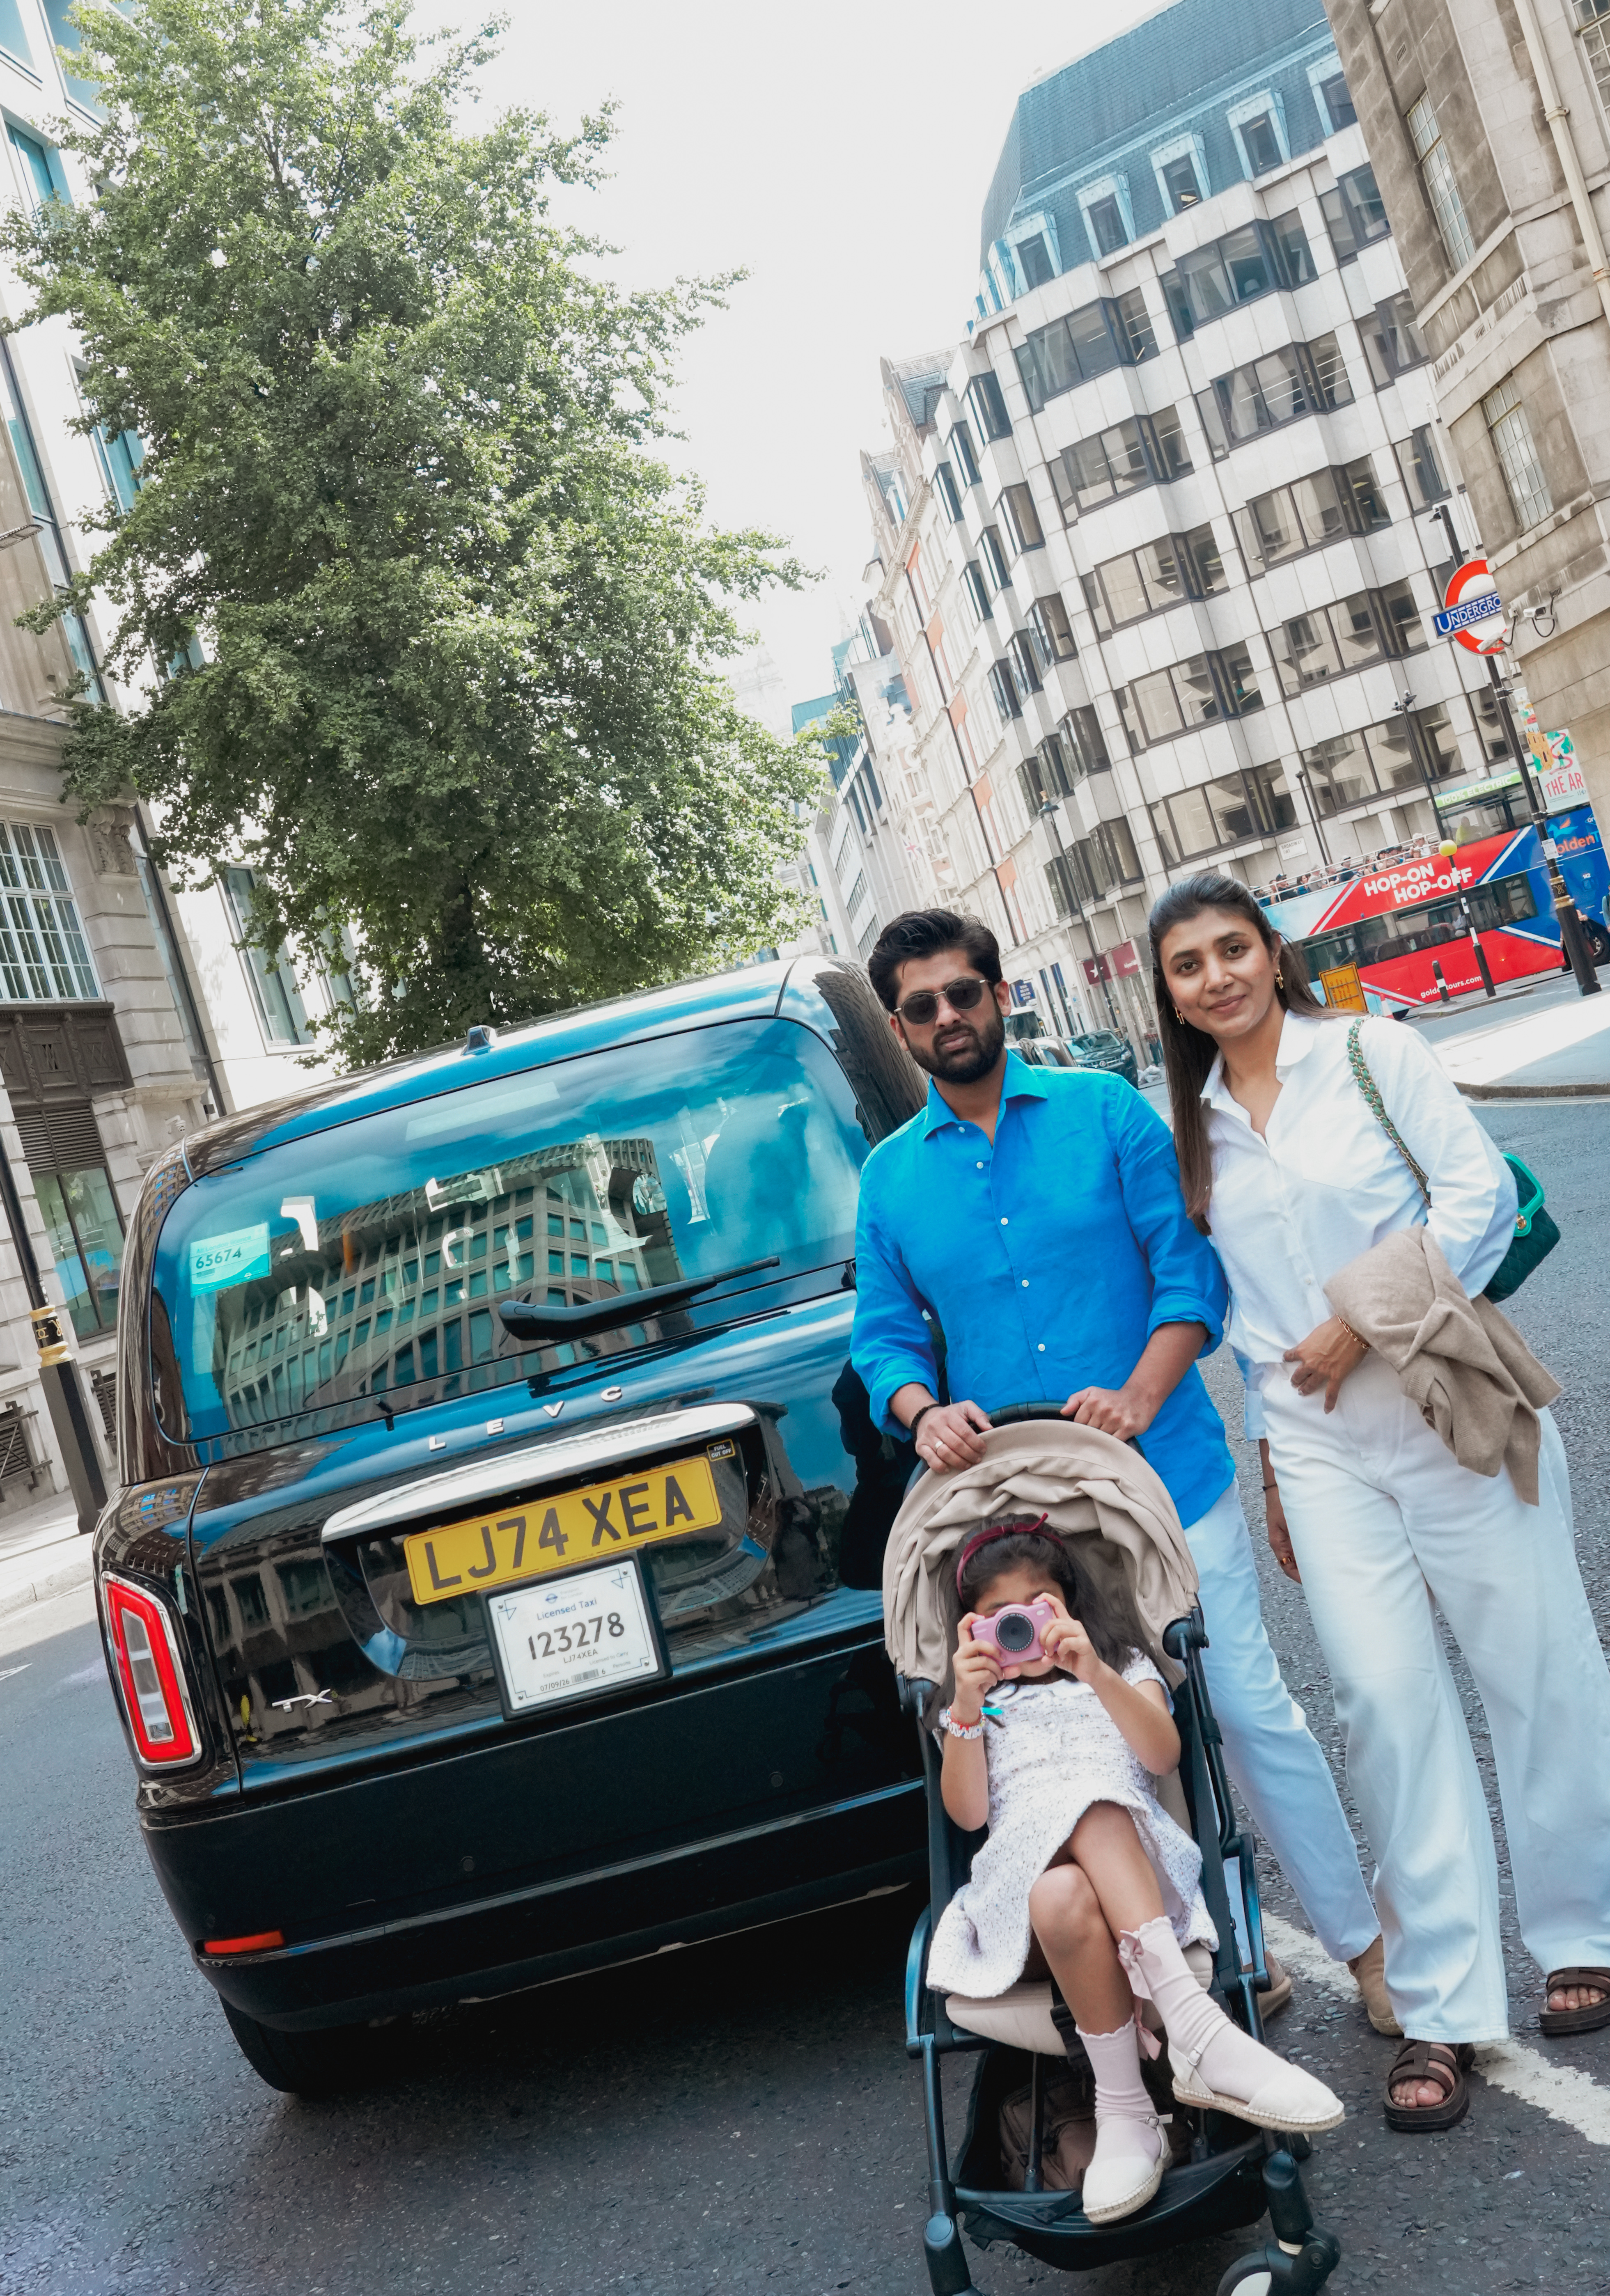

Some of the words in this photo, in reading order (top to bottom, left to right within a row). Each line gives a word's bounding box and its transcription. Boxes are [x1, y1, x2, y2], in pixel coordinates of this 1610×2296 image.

[1437, 596, 1502, 633] UNDERGRO
[1441, 792, 1466, 805] 100%
[1467, 777, 1512, 796] ELECTRIC
[1545, 775, 1567, 797] THE
[1568, 772, 1584, 791] AR
[1281, 840, 1302, 850] BROADWAY
[1557, 830, 1599, 854] oldenT
[1364, 863, 1435, 896] HOP-ON
[1393, 867, 1472, 903] HOP-OFF
[1420, 976, 1482, 999] goldetours.com
[196, 1246, 242, 1269] 65674
[429, 1386, 623, 1452] LEVC
[424, 1507, 568, 1591] LJ74
[582, 1475, 695, 1547] XEA
[536, 1603, 576, 1621] Licensed
[579, 1597, 597, 1609] Taxi
[528, 1612, 625, 1660] 123278
[563, 1649, 598, 1664] LJ74XEA
[589, 1656, 610, 1666] Licensed
[612, 1660, 631, 1668] Persons
[540, 1678, 570, 1691] 07/09/26
[543, 1670, 560, 1678] Expires
